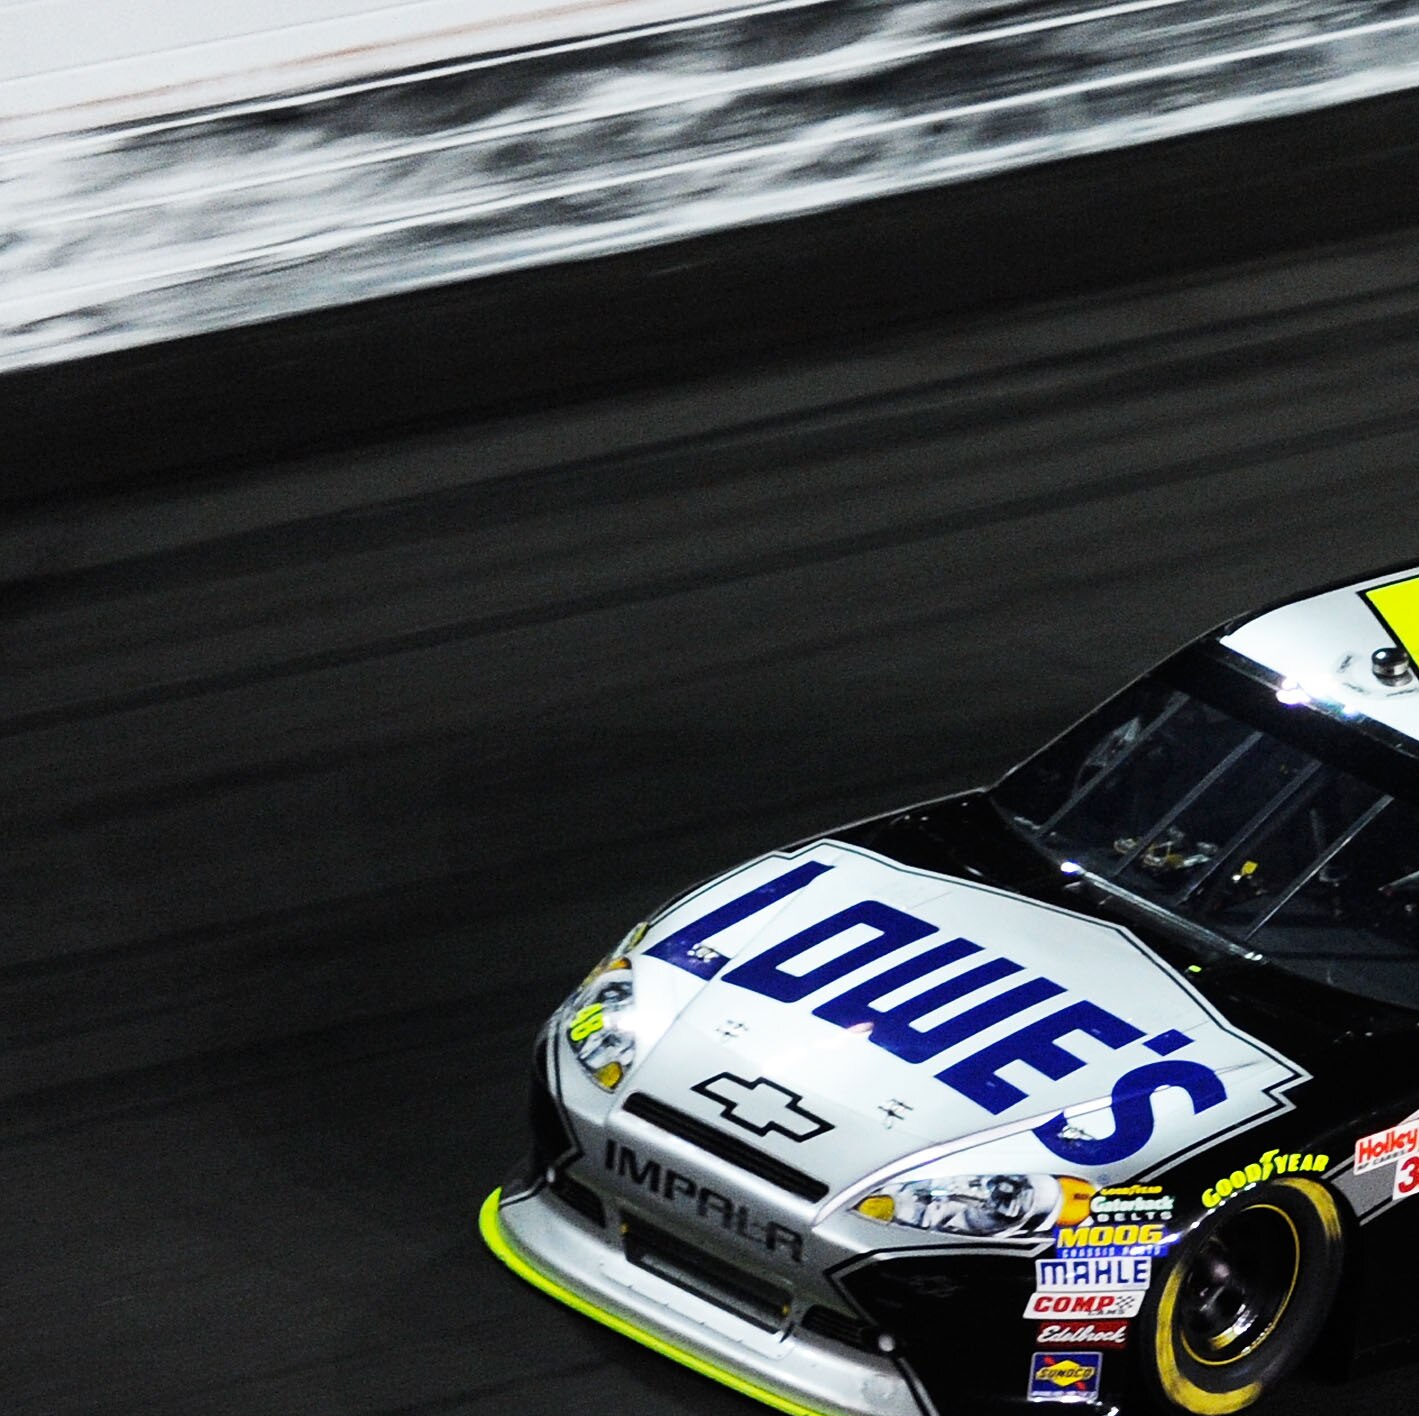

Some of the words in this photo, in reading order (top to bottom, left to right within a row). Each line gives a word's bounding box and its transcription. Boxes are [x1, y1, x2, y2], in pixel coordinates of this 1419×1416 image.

[641, 861, 1230, 1165] LOWE'S
[1357, 1126, 1419, 1164] Holley
[1201, 1148, 1329, 1208] GOODYEAR
[605, 1139, 804, 1263] IMPALA
[1057, 1223, 1166, 1249] MOOG
[1040, 1260, 1149, 1286] MAHLE
[1033, 1295, 1115, 1313] COMP
[1036, 1324, 1128, 1344] Edelbrock
[1036, 1367, 1094, 1380] SUNOCO
